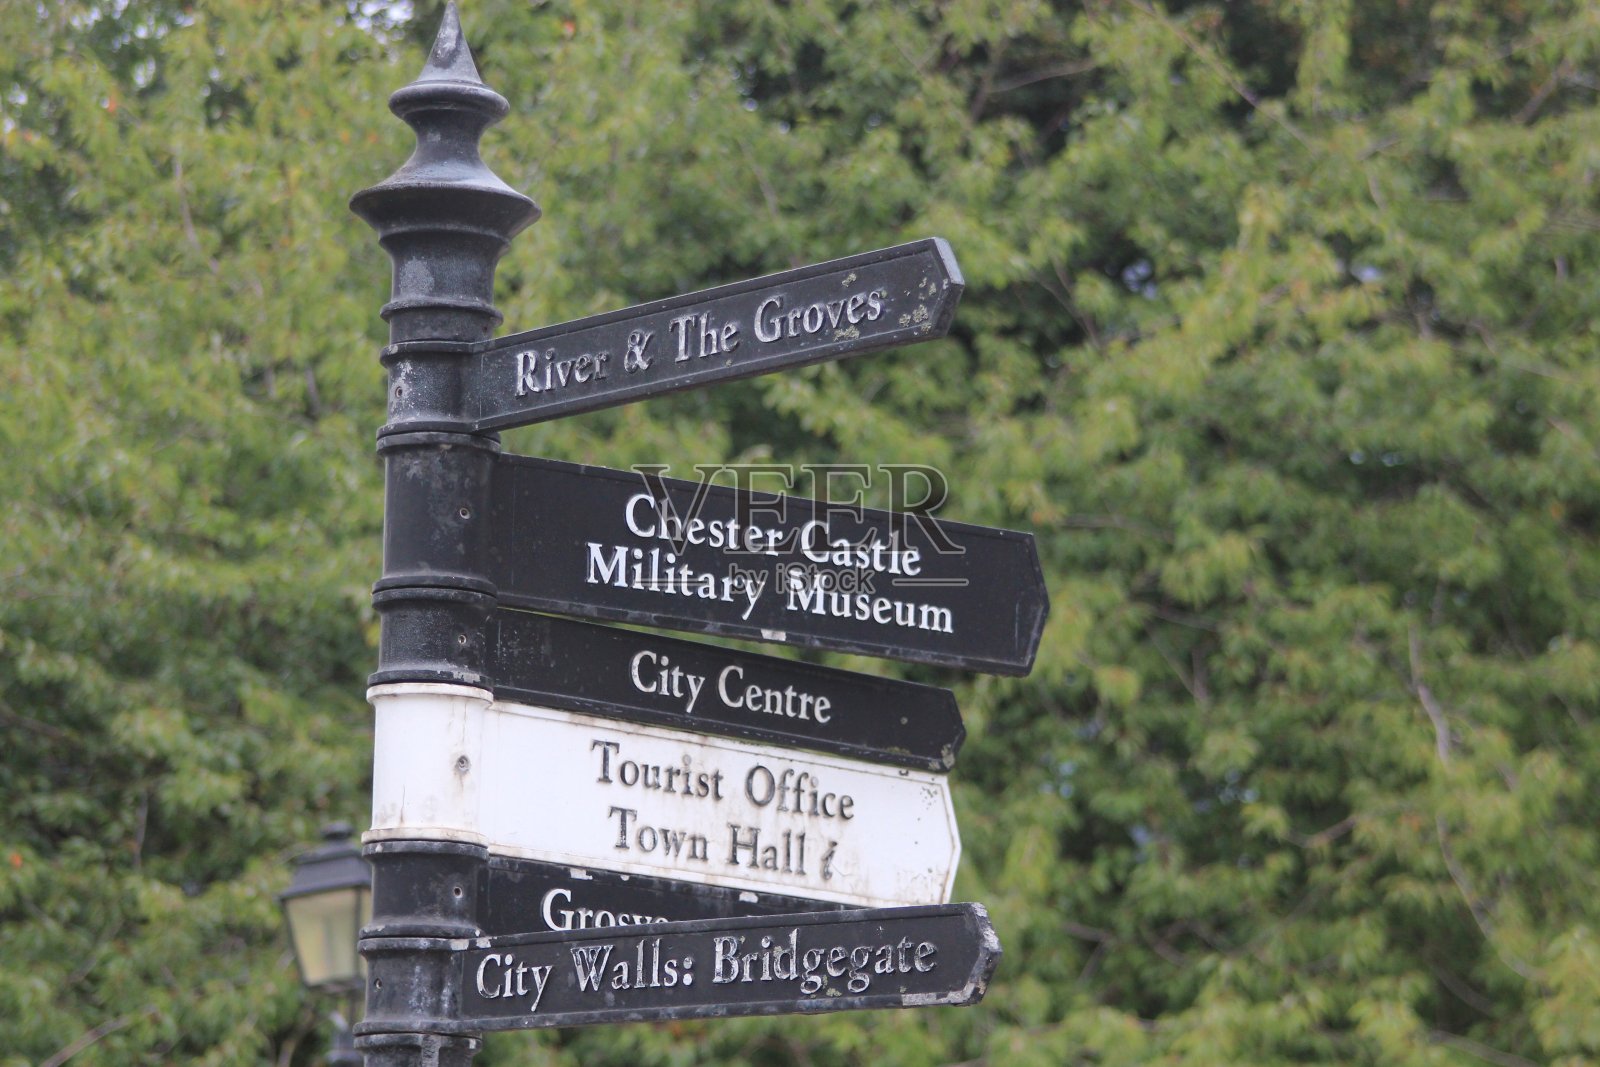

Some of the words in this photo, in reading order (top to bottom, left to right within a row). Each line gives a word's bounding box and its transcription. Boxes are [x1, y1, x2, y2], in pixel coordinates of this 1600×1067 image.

[515, 347, 608, 398] River
[624, 328, 653, 373] &
[669, 312, 738, 363] The
[753, 286, 884, 344] Groves
[624, 493, 784, 557] Chester
[800, 518, 922, 577] Castle
[585, 541, 764, 622] Military
[786, 568, 954, 635] Museum
[630, 650, 706, 714] City
[718, 665, 833, 725] Centre
[592, 739, 723, 802] Tourist
[745, 764, 855, 822] Office
[608, 806, 709, 863] Town
[726, 822, 807, 877] Hall
[541, 888, 669, 932] Gros
[475, 952, 553, 1013] City
[570, 937, 694, 992] Walls:
[712, 928, 937, 996] Bridgegate
